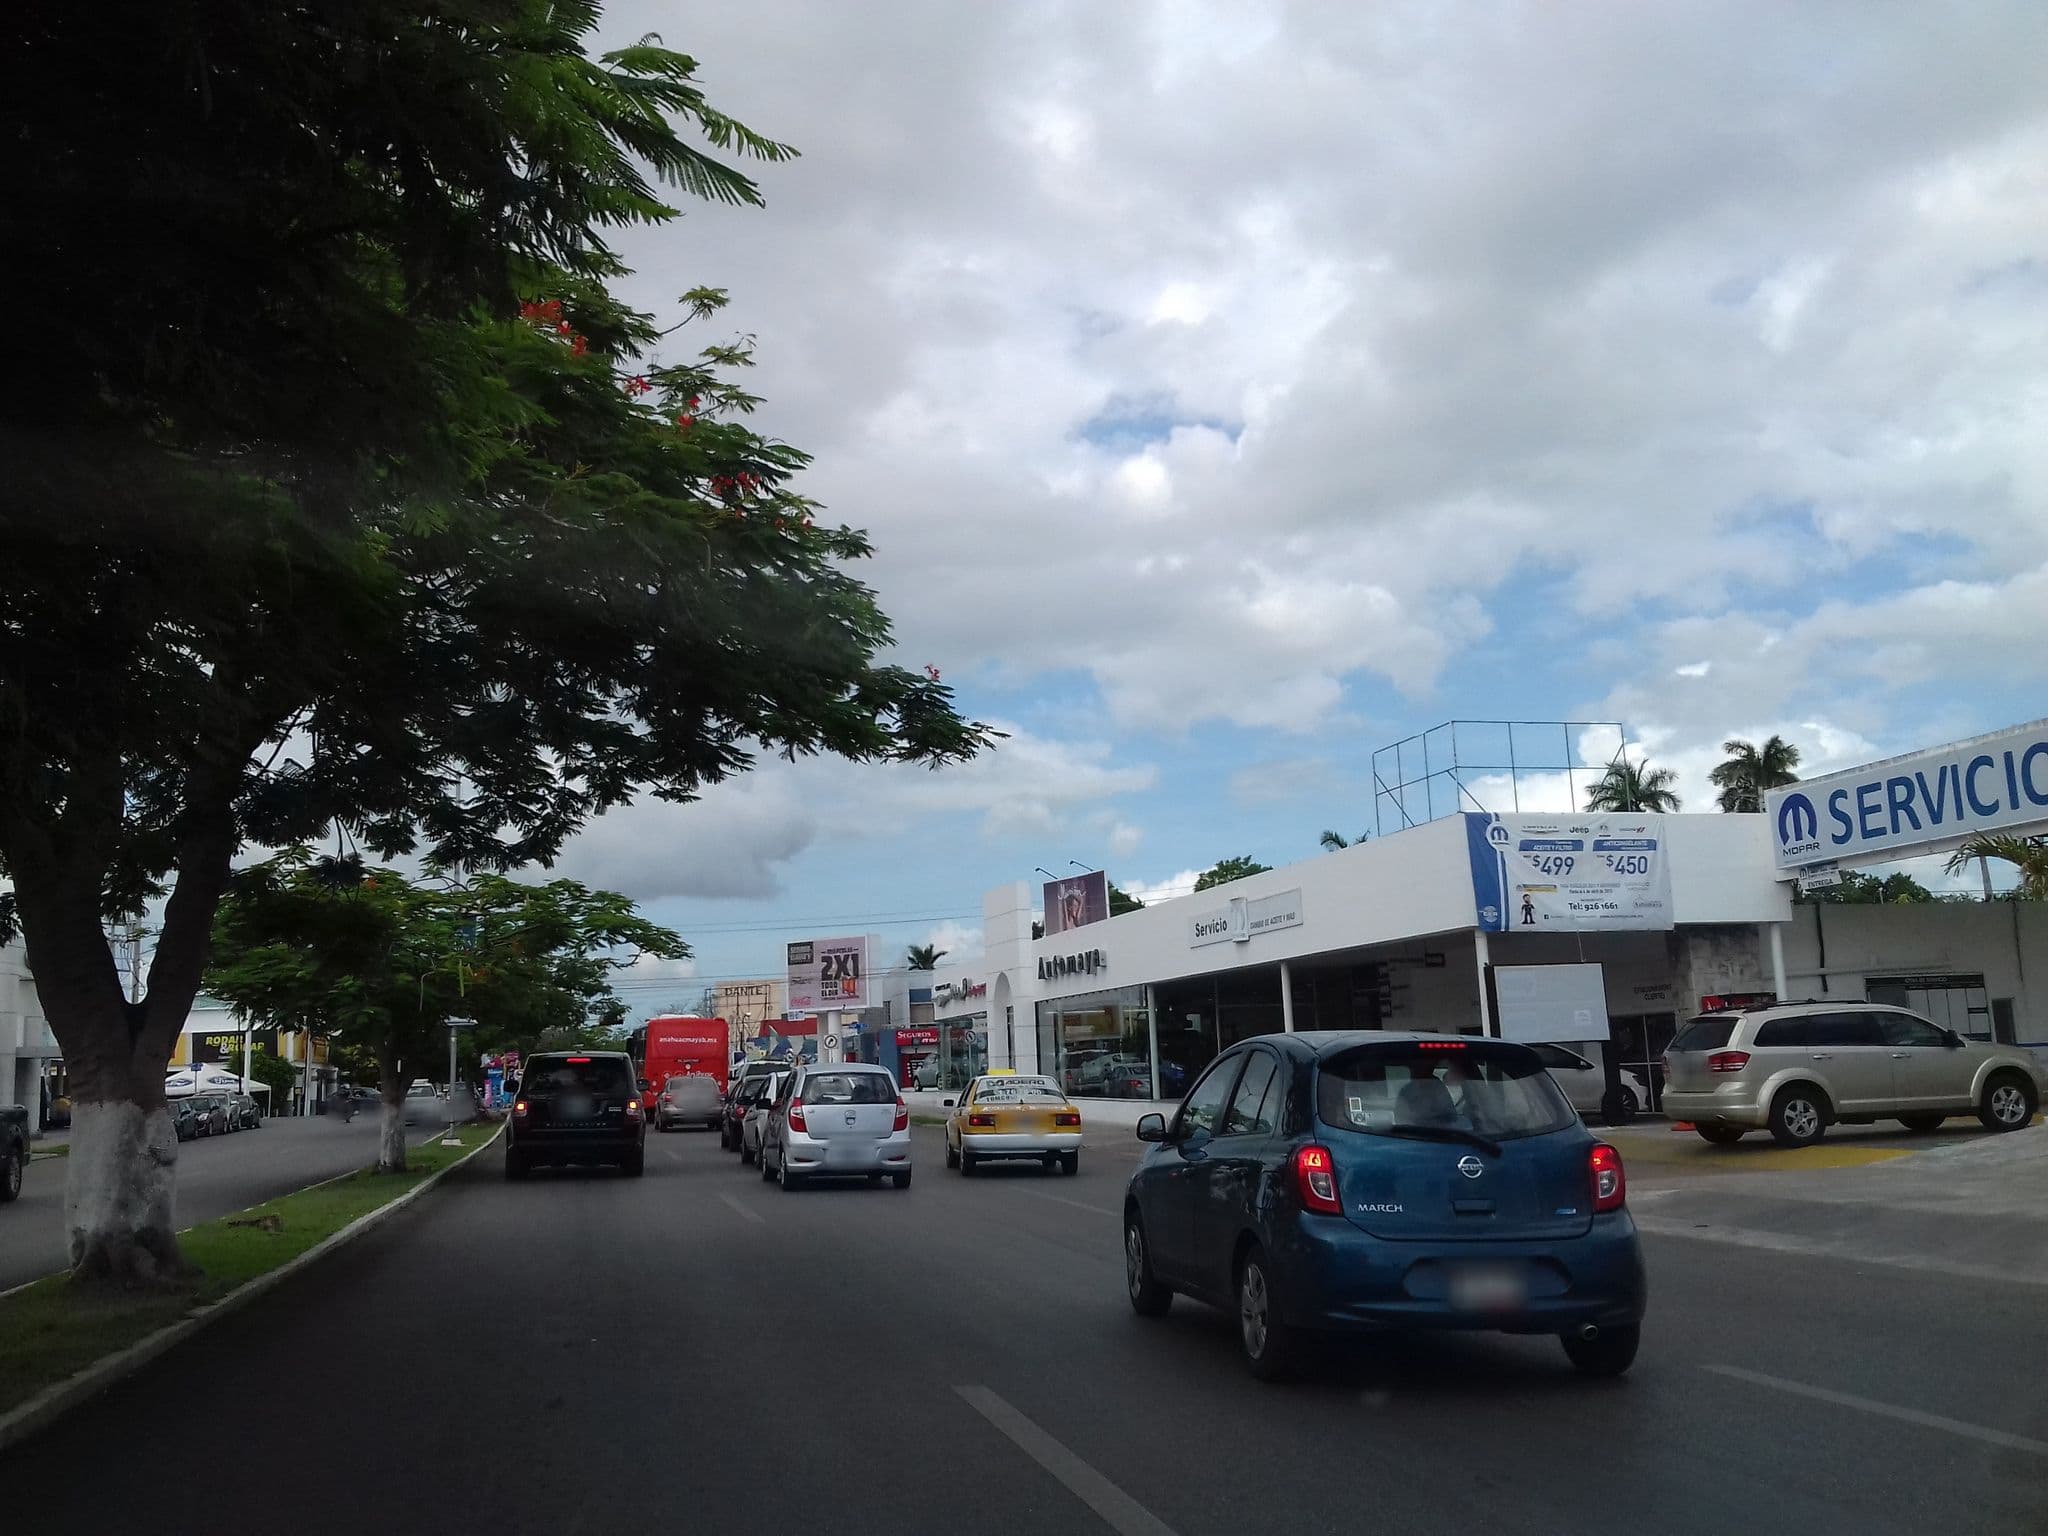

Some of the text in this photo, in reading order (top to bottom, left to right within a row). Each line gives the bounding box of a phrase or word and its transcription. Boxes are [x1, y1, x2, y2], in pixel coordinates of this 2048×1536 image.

[1827, 742, 2048, 845] SERVICIO
[1569, 826, 1590, 834] Jeep
[1783, 842, 1820, 856] MOPAR
[1532, 855, 1574, 876] $499
[1606, 854, 1648, 875] $450
[1568, 902, 1618, 912] Tel: 926 1661
[1195, 917, 1228, 938] Servicio
[725, 985, 764, 997] DANTE
[1358, 1203, 1403, 1213] MARCH
